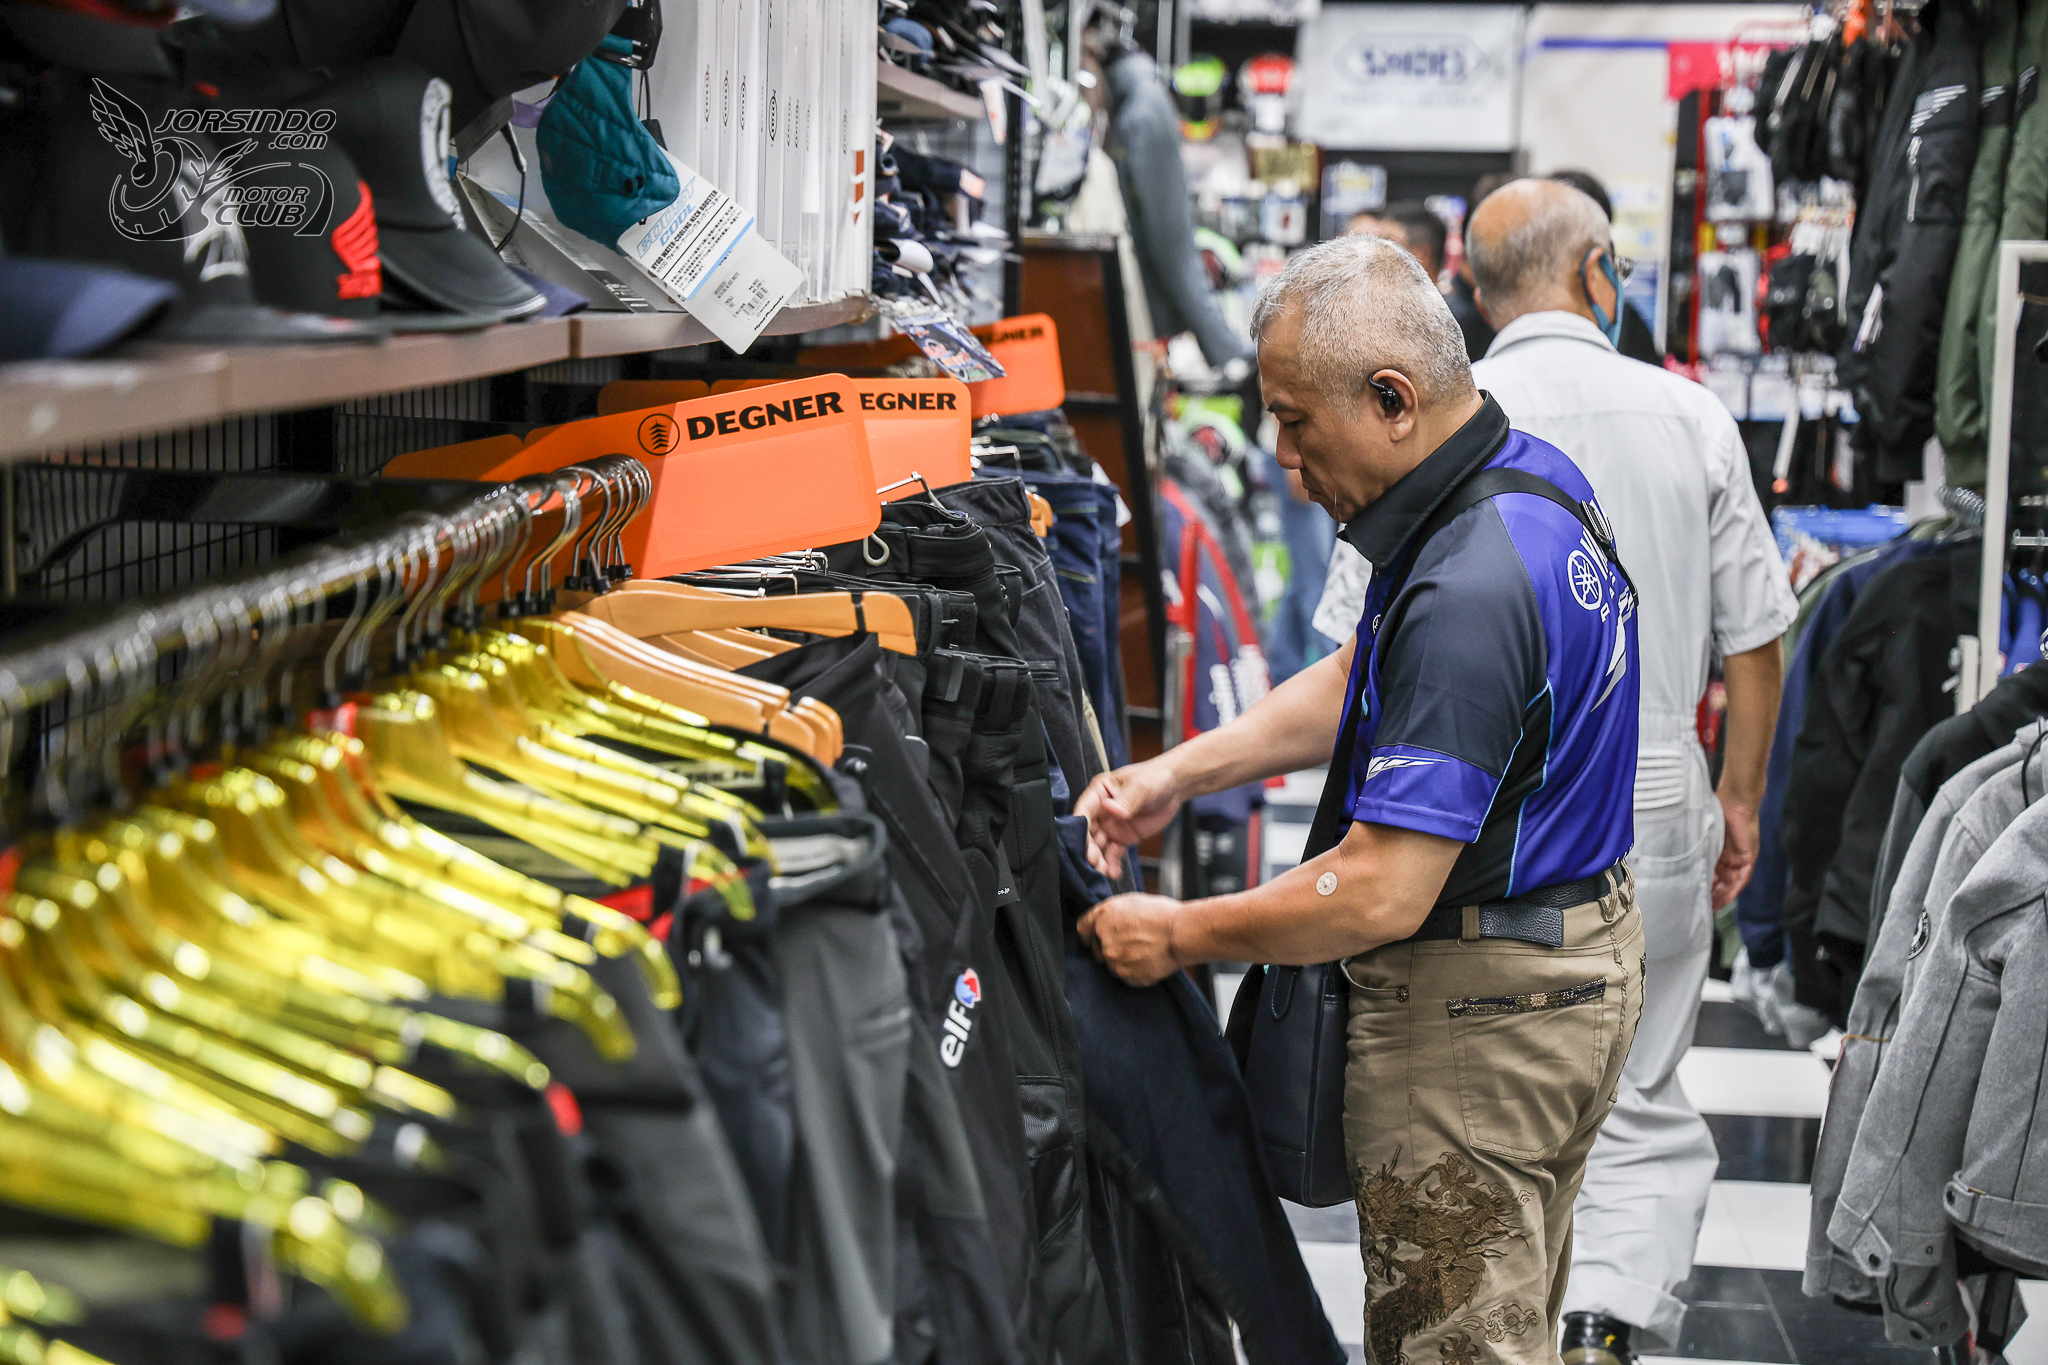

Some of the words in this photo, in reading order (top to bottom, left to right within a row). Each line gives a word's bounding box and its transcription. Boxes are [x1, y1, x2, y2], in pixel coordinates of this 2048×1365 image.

[660, 204, 696, 246] COOL
[686, 391, 844, 441] DEGNER
[860, 393, 957, 411] EGNER
[940, 999, 973, 1068] elf
